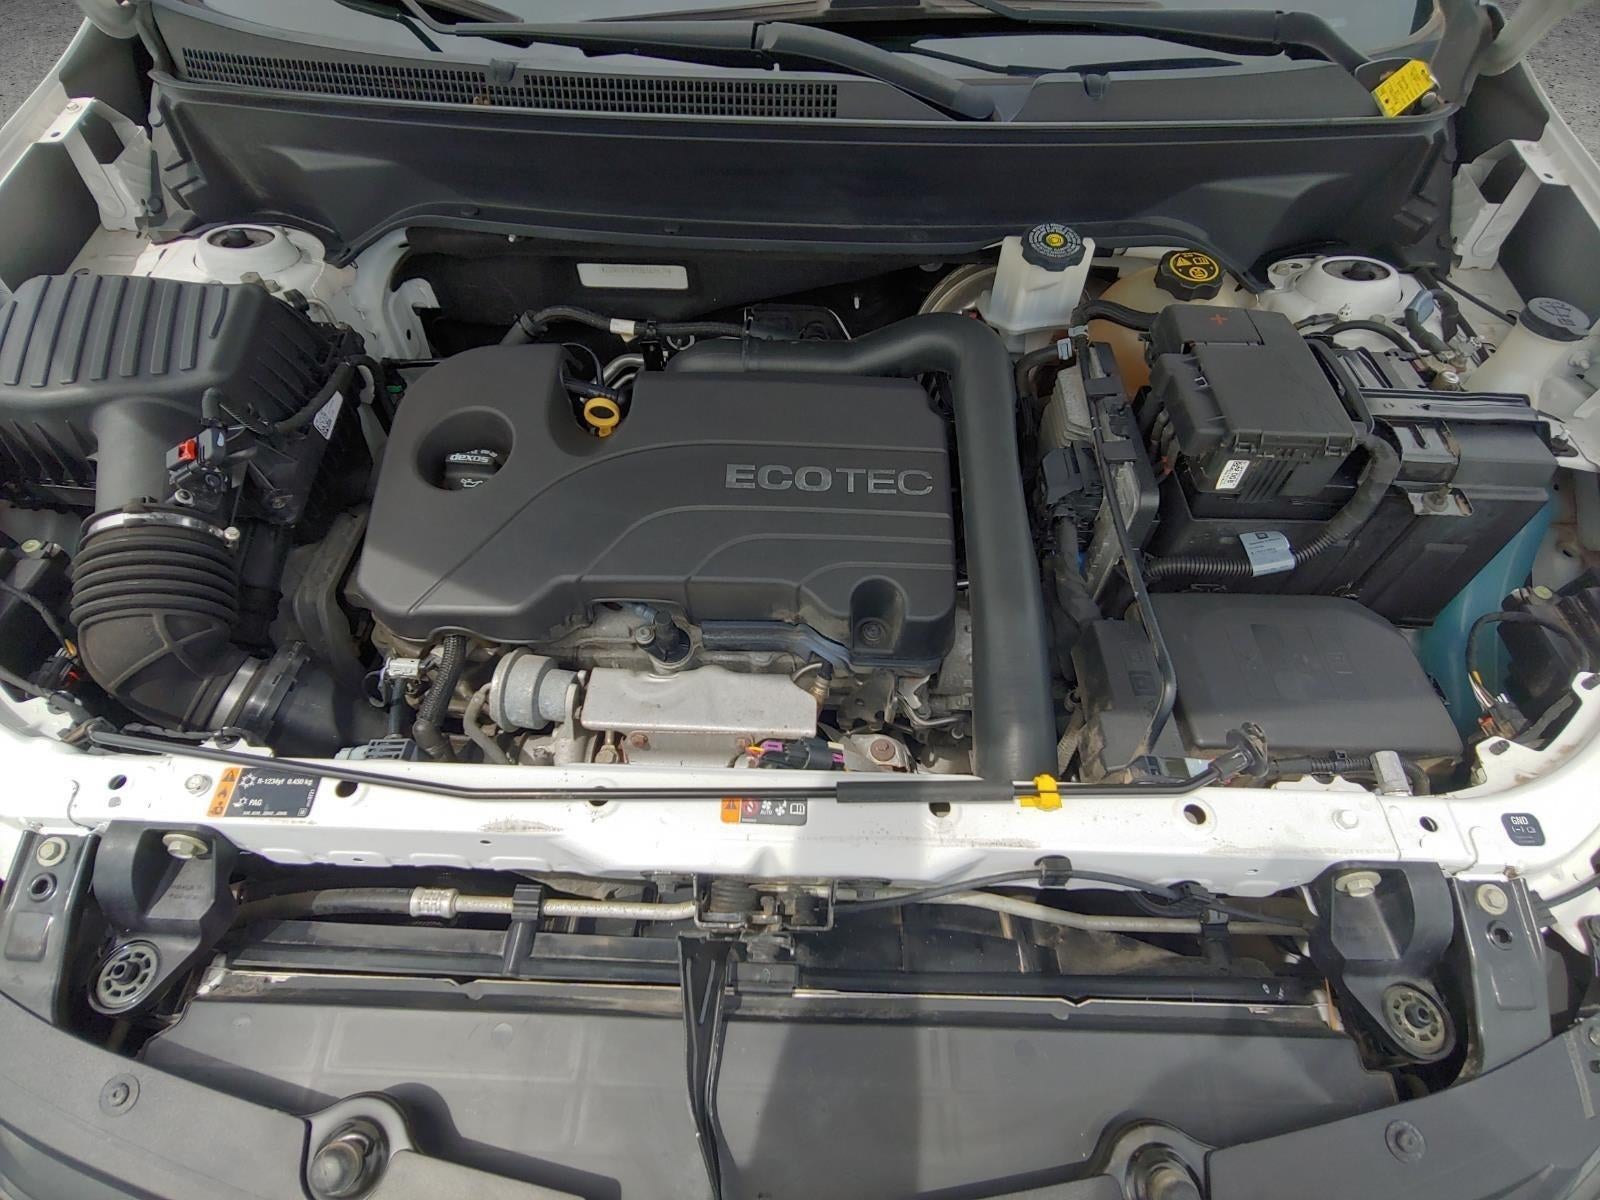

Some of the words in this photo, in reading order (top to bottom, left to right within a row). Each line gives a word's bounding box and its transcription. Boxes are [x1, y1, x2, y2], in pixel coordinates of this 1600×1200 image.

[449, 452, 489, 463] dexos
[725, 463, 934, 496] ECOTEC
[1510, 815, 1529, 825] GND
